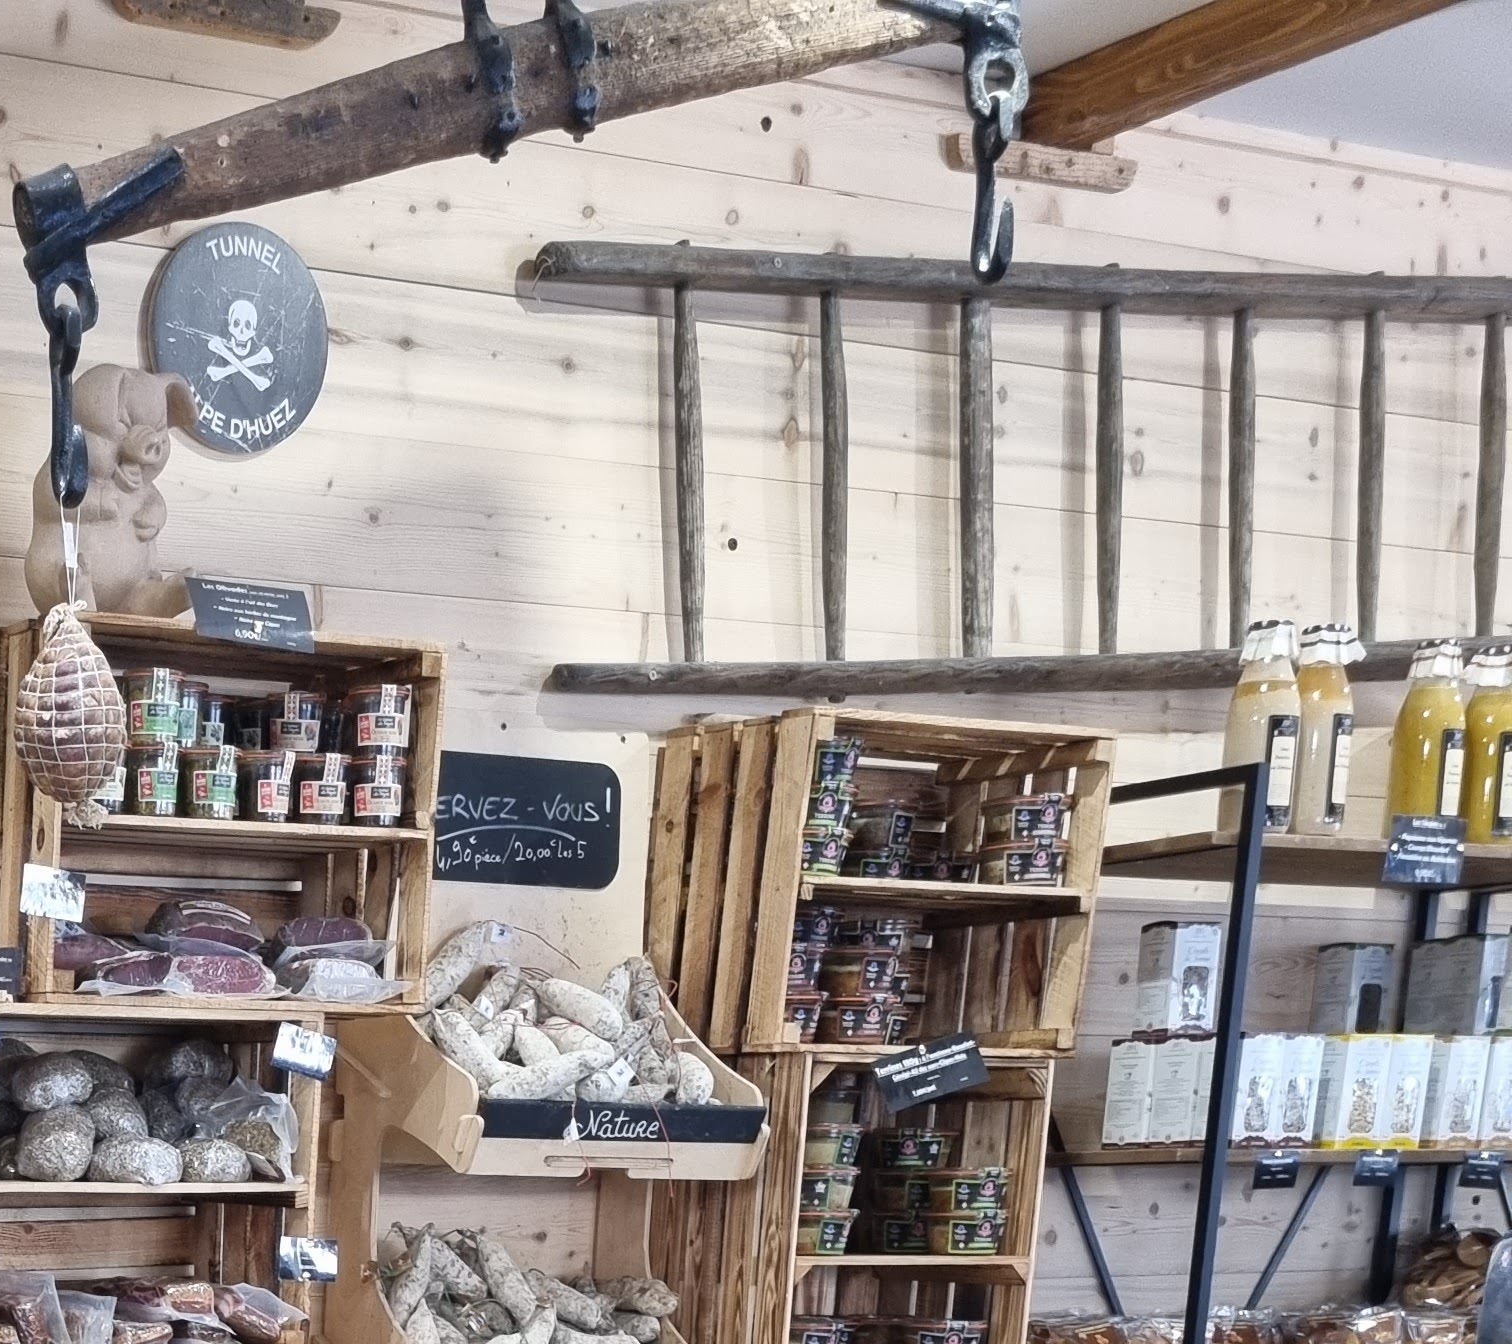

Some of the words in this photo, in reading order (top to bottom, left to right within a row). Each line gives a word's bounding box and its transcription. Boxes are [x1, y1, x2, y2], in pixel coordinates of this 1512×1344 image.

[205, 235, 281, 275] TUNNEL
[229, 397, 297, 440] D'HUEZ
[435, 793, 519, 820] ERVEZ
[542, 793, 600, 822] VOUS
[577, 1110, 660, 1139] Nature
